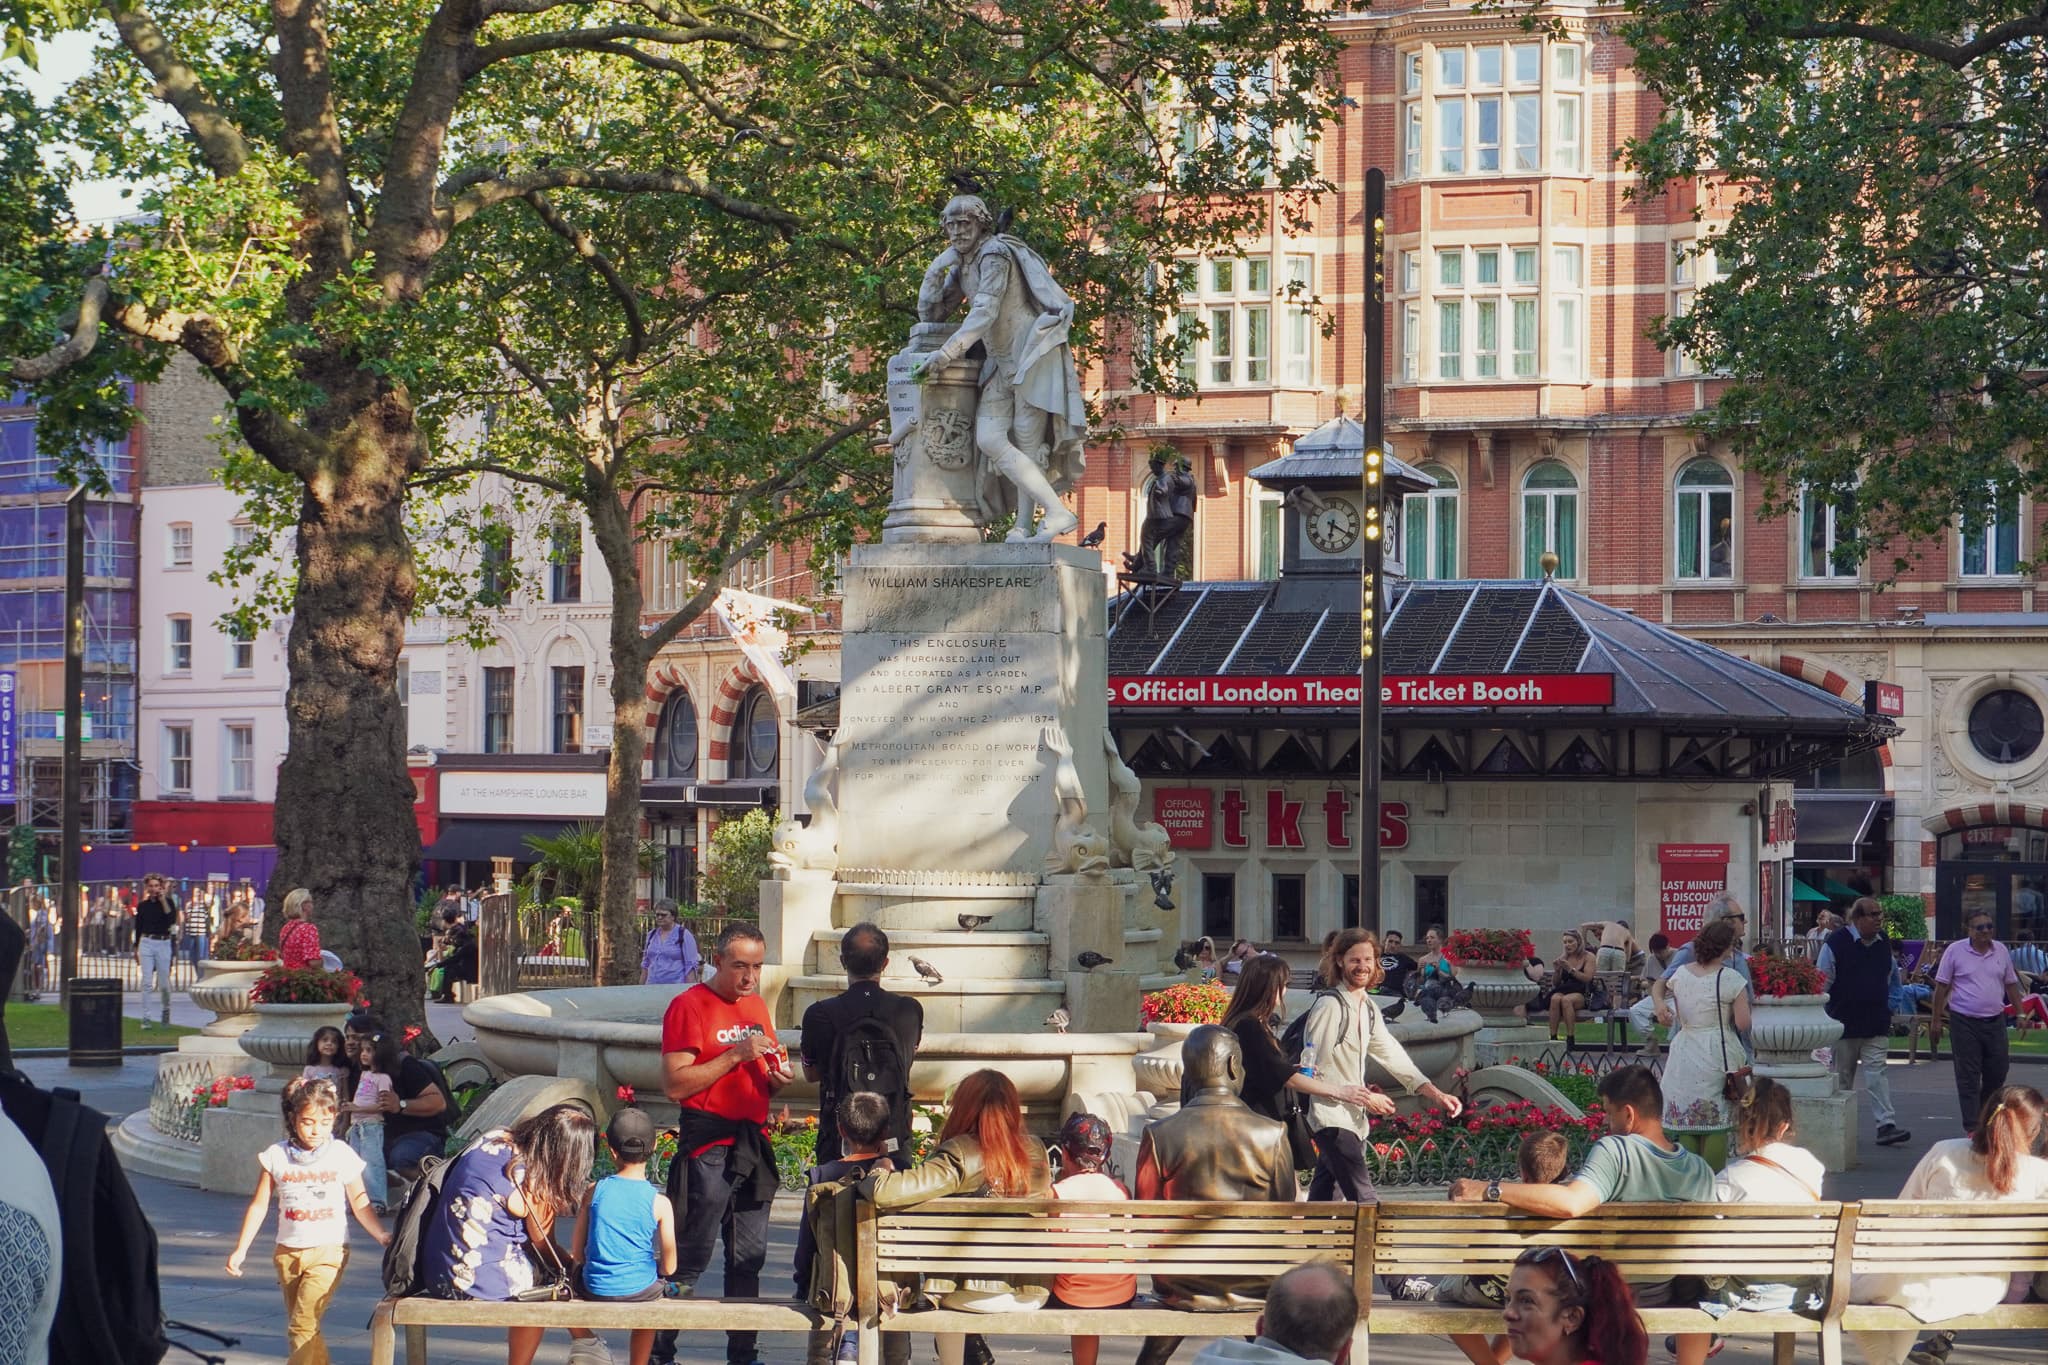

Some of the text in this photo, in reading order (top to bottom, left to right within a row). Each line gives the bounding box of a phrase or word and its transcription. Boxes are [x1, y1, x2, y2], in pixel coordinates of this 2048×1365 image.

[868, 577, 1032, 588] WILLIAM SHAKESPEARE
[891, 639, 1007, 648] THIS ENCLOSURE
[971, 655, 994, 663] LAID
[987, 670, 1027, 678] GARDEN
[873, 685, 920, 693] ALBERT
[927, 685, 968, 693] GRANT
[1020, 685, 1045, 694] M.P.
[1122, 680, 1206, 701] Official
[1212, 681, 1297, 701] London
[1303, 681, 1393, 701] Theae
[1398, 680, 1467, 701] Ticket
[1473, 680, 1543, 701] Booth
[1031, 715, 1055, 723] 1874
[1, 696, 11, 791] COLLINS
[852, 743, 935, 751] METROPOLITAN
[986, 743, 1000, 751] OF
[1006, 743, 1045, 751] WORKS
[460, 787, 588, 799] AT THE HAMPSHIRE LOUNGE BAR
[1164, 799, 1202, 808] OFFICIAL
[1162, 809, 1205, 818] LONDON
[1219, 788, 1409, 848] tkts
[1163, 819, 1204, 828] THEATRE
[1173, 829, 1193, 837] .com
[1662, 880, 1724, 890] LAST MINUTE
[1662, 892, 1720, 902] & DISCOUN
[1665, 904, 1708, 917] THEAT
[1667, 918, 1705, 931] TICKE
